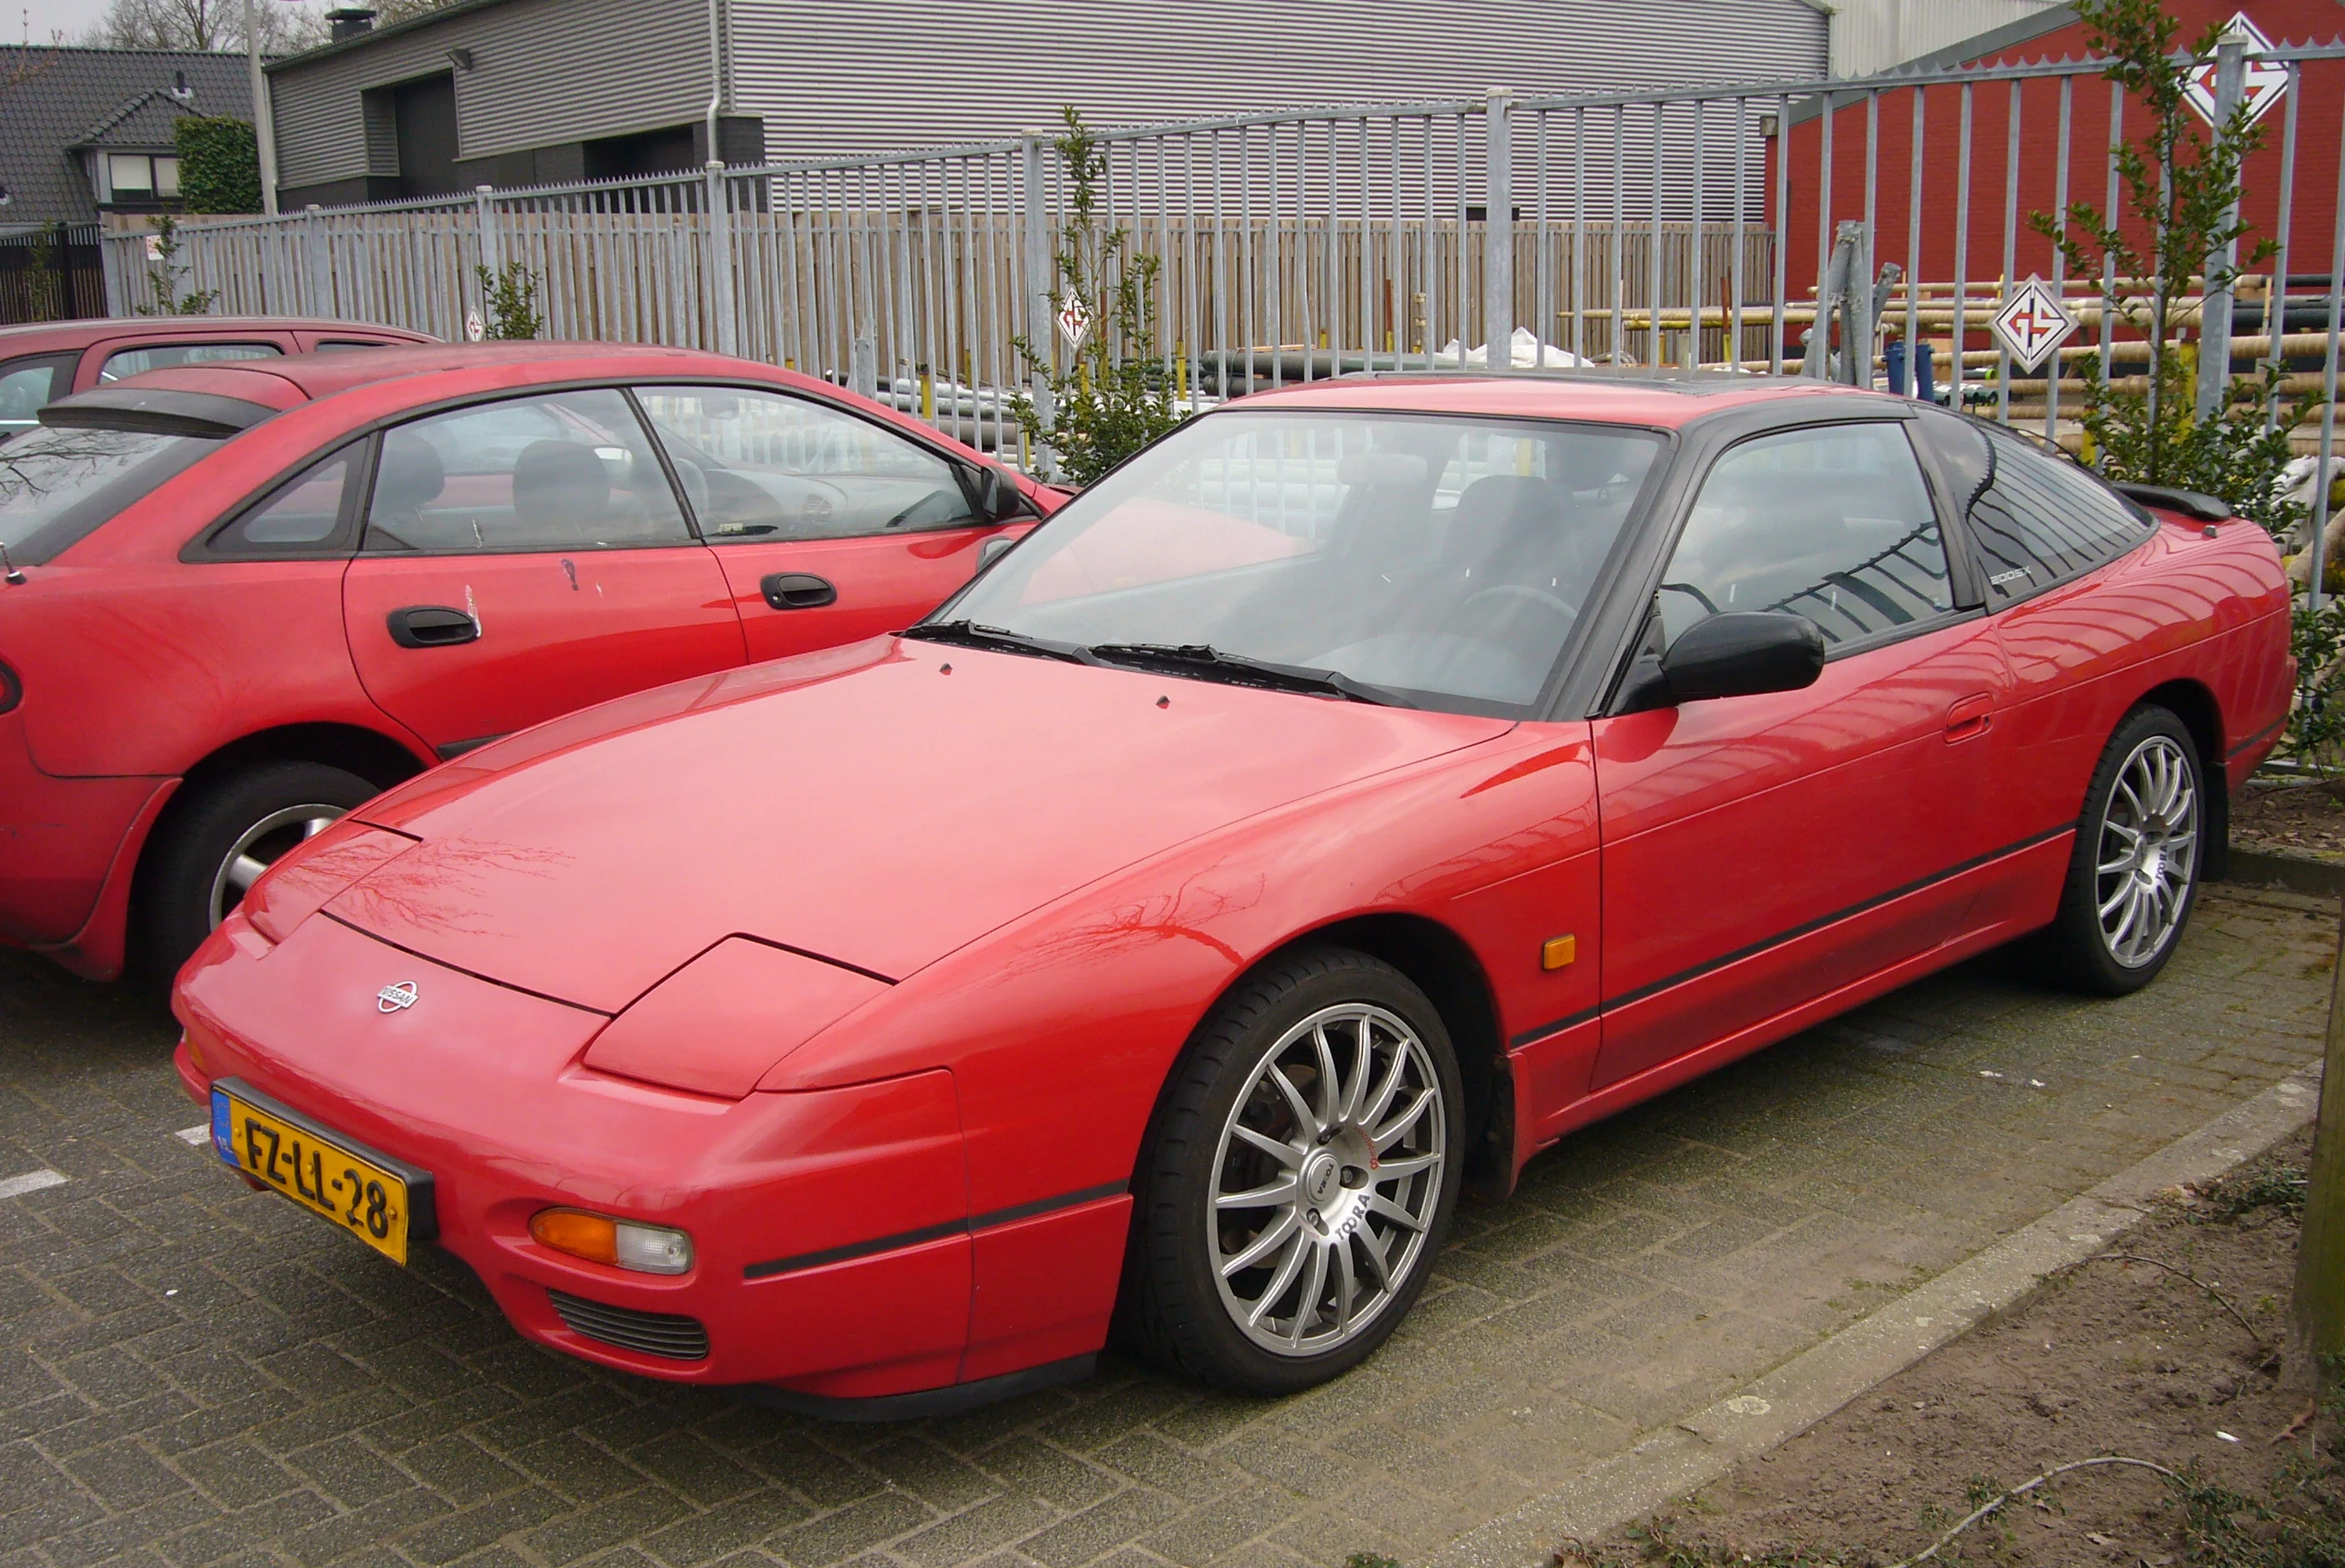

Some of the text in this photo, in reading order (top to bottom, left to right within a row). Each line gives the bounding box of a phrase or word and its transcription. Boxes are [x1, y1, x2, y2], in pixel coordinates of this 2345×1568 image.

[1998, 286, 2067, 360] GS
[1989, 566, 2032, 585] 200SX
[382, 986, 415, 1004] NISSAN
[245, 1117, 389, 1239] FZ-LL-28
[1334, 1193, 1371, 1241] TOORA
